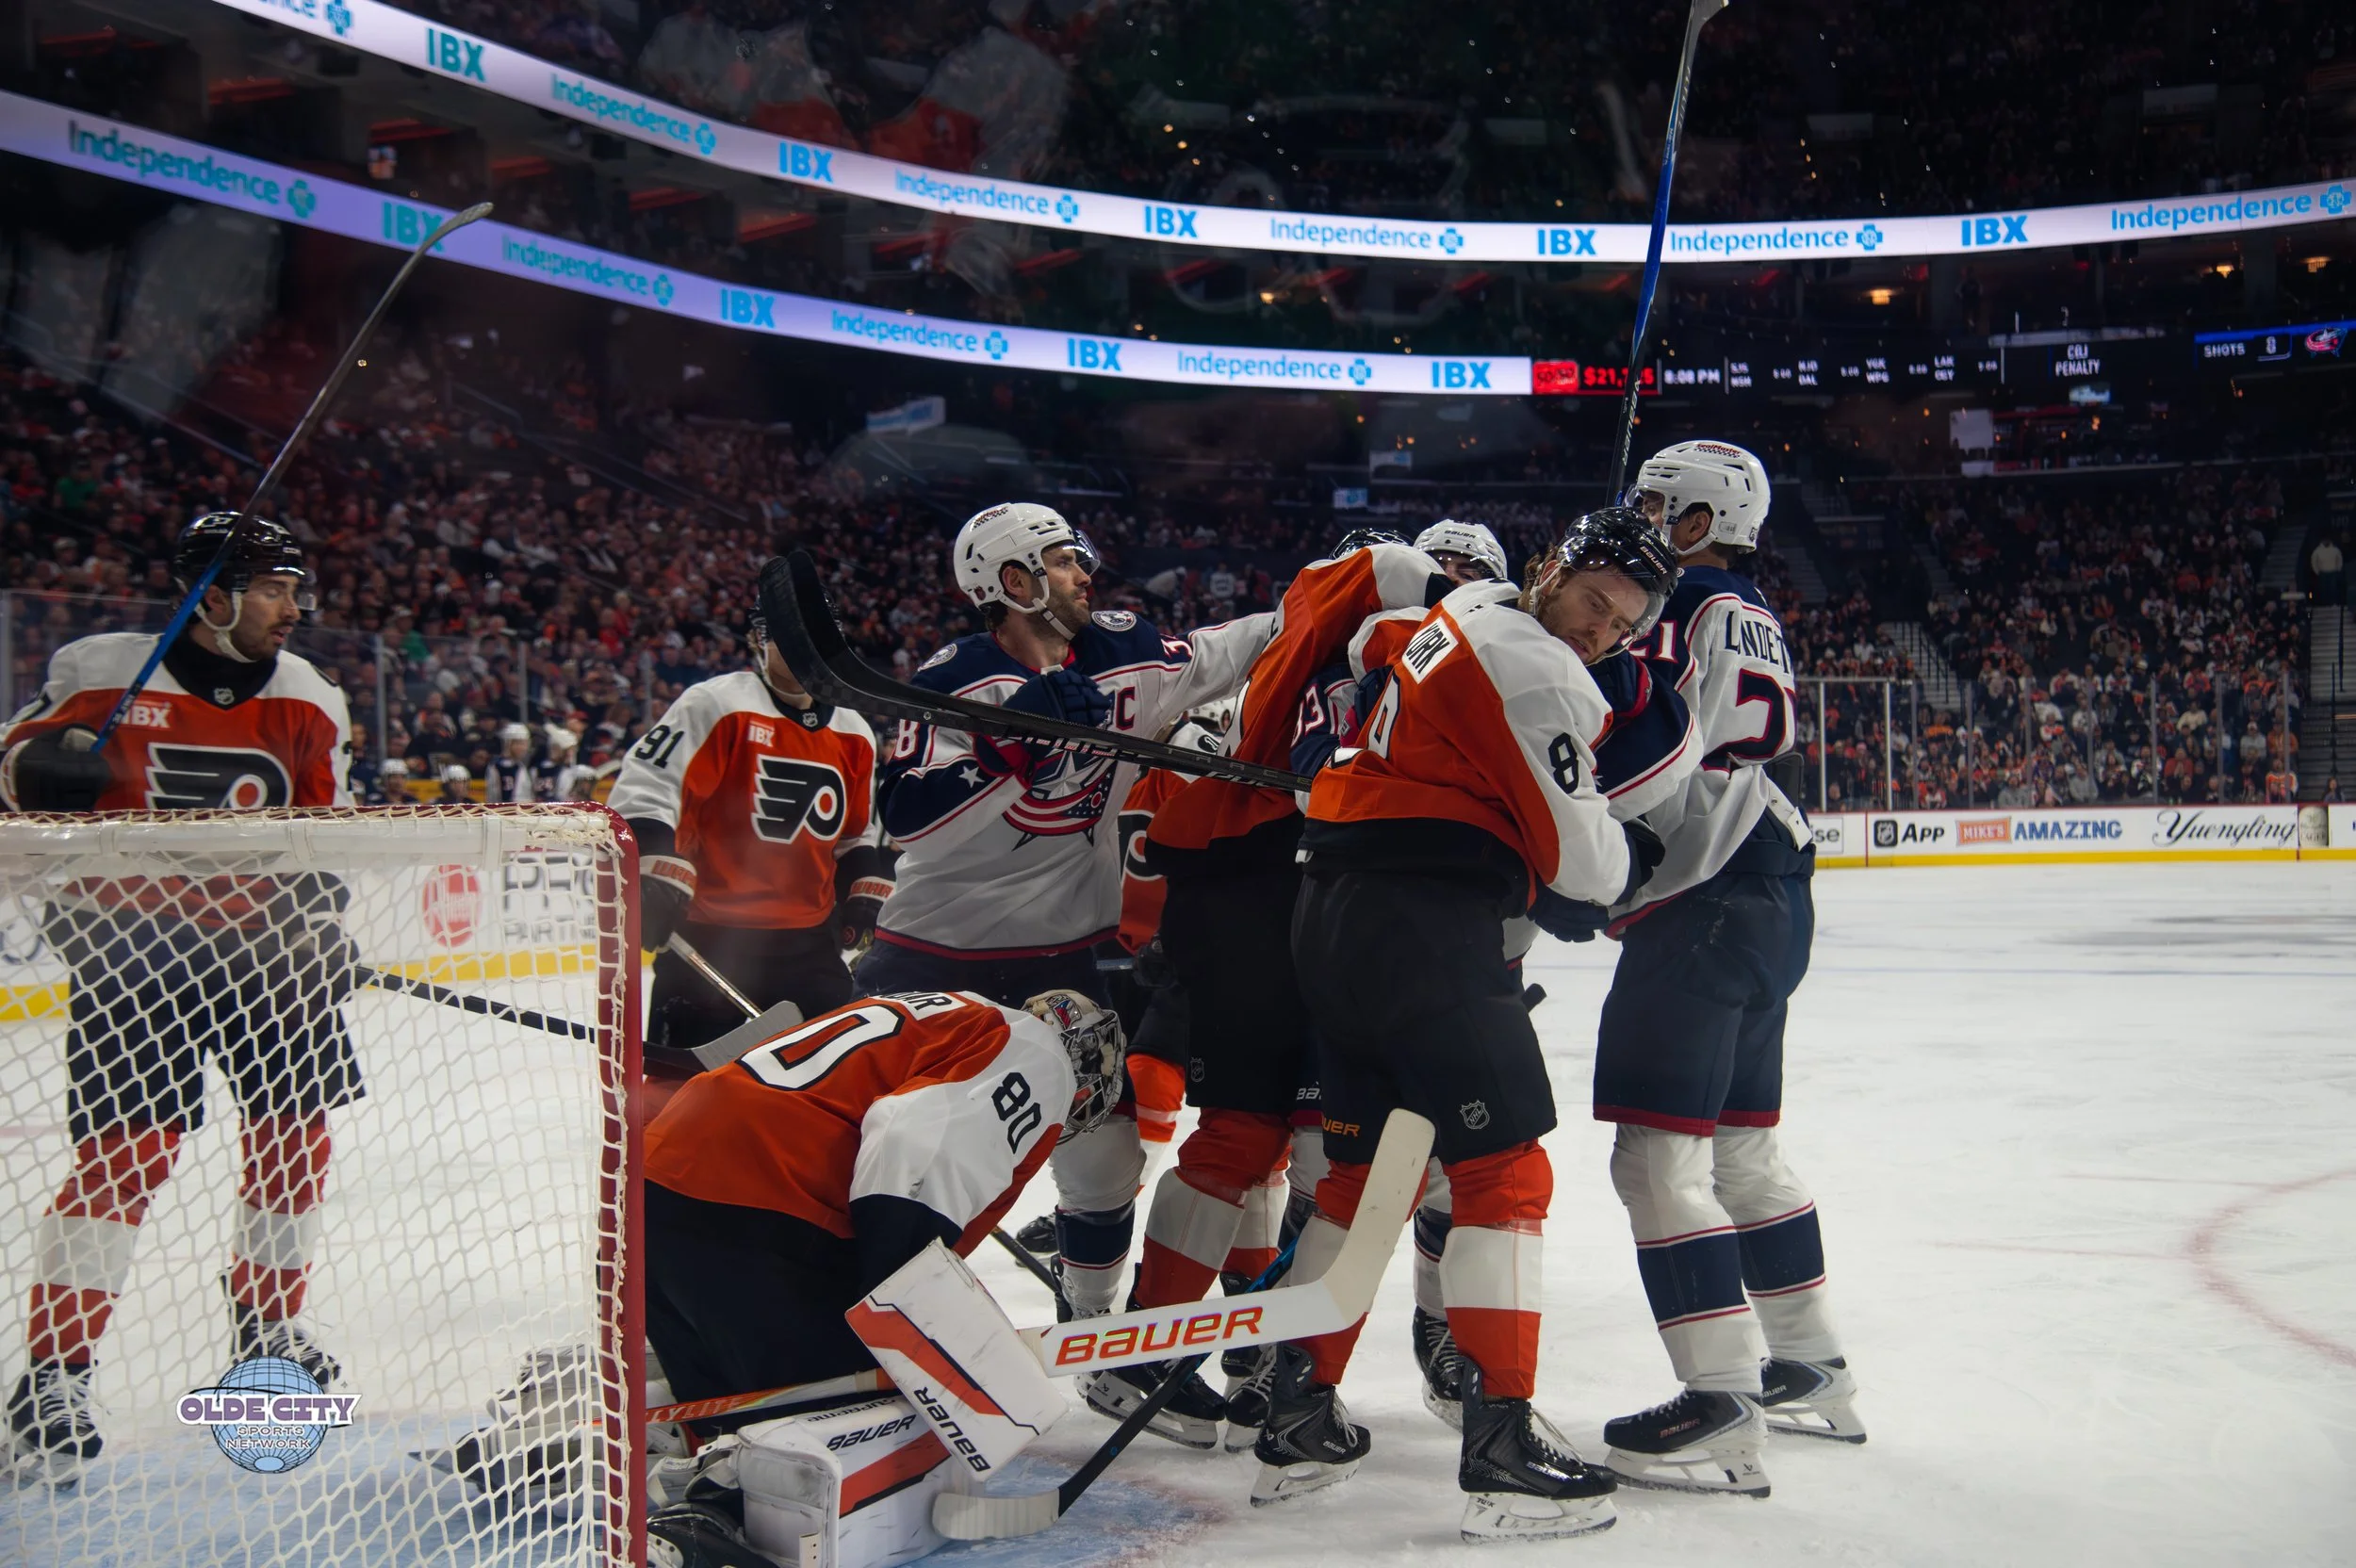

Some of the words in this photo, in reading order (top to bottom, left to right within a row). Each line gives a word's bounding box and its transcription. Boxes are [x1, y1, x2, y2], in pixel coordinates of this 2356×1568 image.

[426, 28, 486, 83] IBX
[550, 74, 692, 144] Independence
[779, 142, 833, 183] IBX
[895, 170, 1049, 213] Independence
[1144, 206, 1199, 238] IBX
[1270, 218, 1431, 249] Independence
[1538, 229, 1596, 255] IBX
[1671, 227, 1848, 254] Independence
[1961, 216, 2028, 246] IBX
[2112, 192, 2312, 230] Independence
[69, 121, 280, 205] Independence
[383, 202, 444, 252] IBX
[502, 234, 649, 295] Independence
[721, 288, 775, 328] IBX
[832, 310, 977, 352] Independence
[1068, 338, 1121, 371] IBX
[1178, 351, 1341, 382] Independence
[1432, 362, 1490, 388] IBX
[2203, 343, 2246, 358] SHOTS
[1697, 368, 1721, 384] PM
[2055, 359, 2102, 376] PENALTY
[1444, 530, 1477, 539] BAUER
[1640, 547, 1667, 575] BAUER
[1115, 687, 1136, 730] C
[634, 724, 685, 769] 91
[747, 724, 775, 747] IBX
[1547, 732, 1579, 794] 8
[2014, 820, 2122, 841] AMAZING
[2152, 809, 2297, 847] Yuengling
[991, 1071, 1041, 1154] 80
[1055, 1306, 1263, 1366] BAUER
[646, 1396, 744, 1424] LYLITE
[826, 1413, 917, 1451] BAUER
[914, 1387, 991, 1473] BAUER
[1659, 1417, 1700, 1440] BAUER
[1322, 1440, 1347, 1454] BAUER
[1527, 1461, 1569, 1481] BAUER
